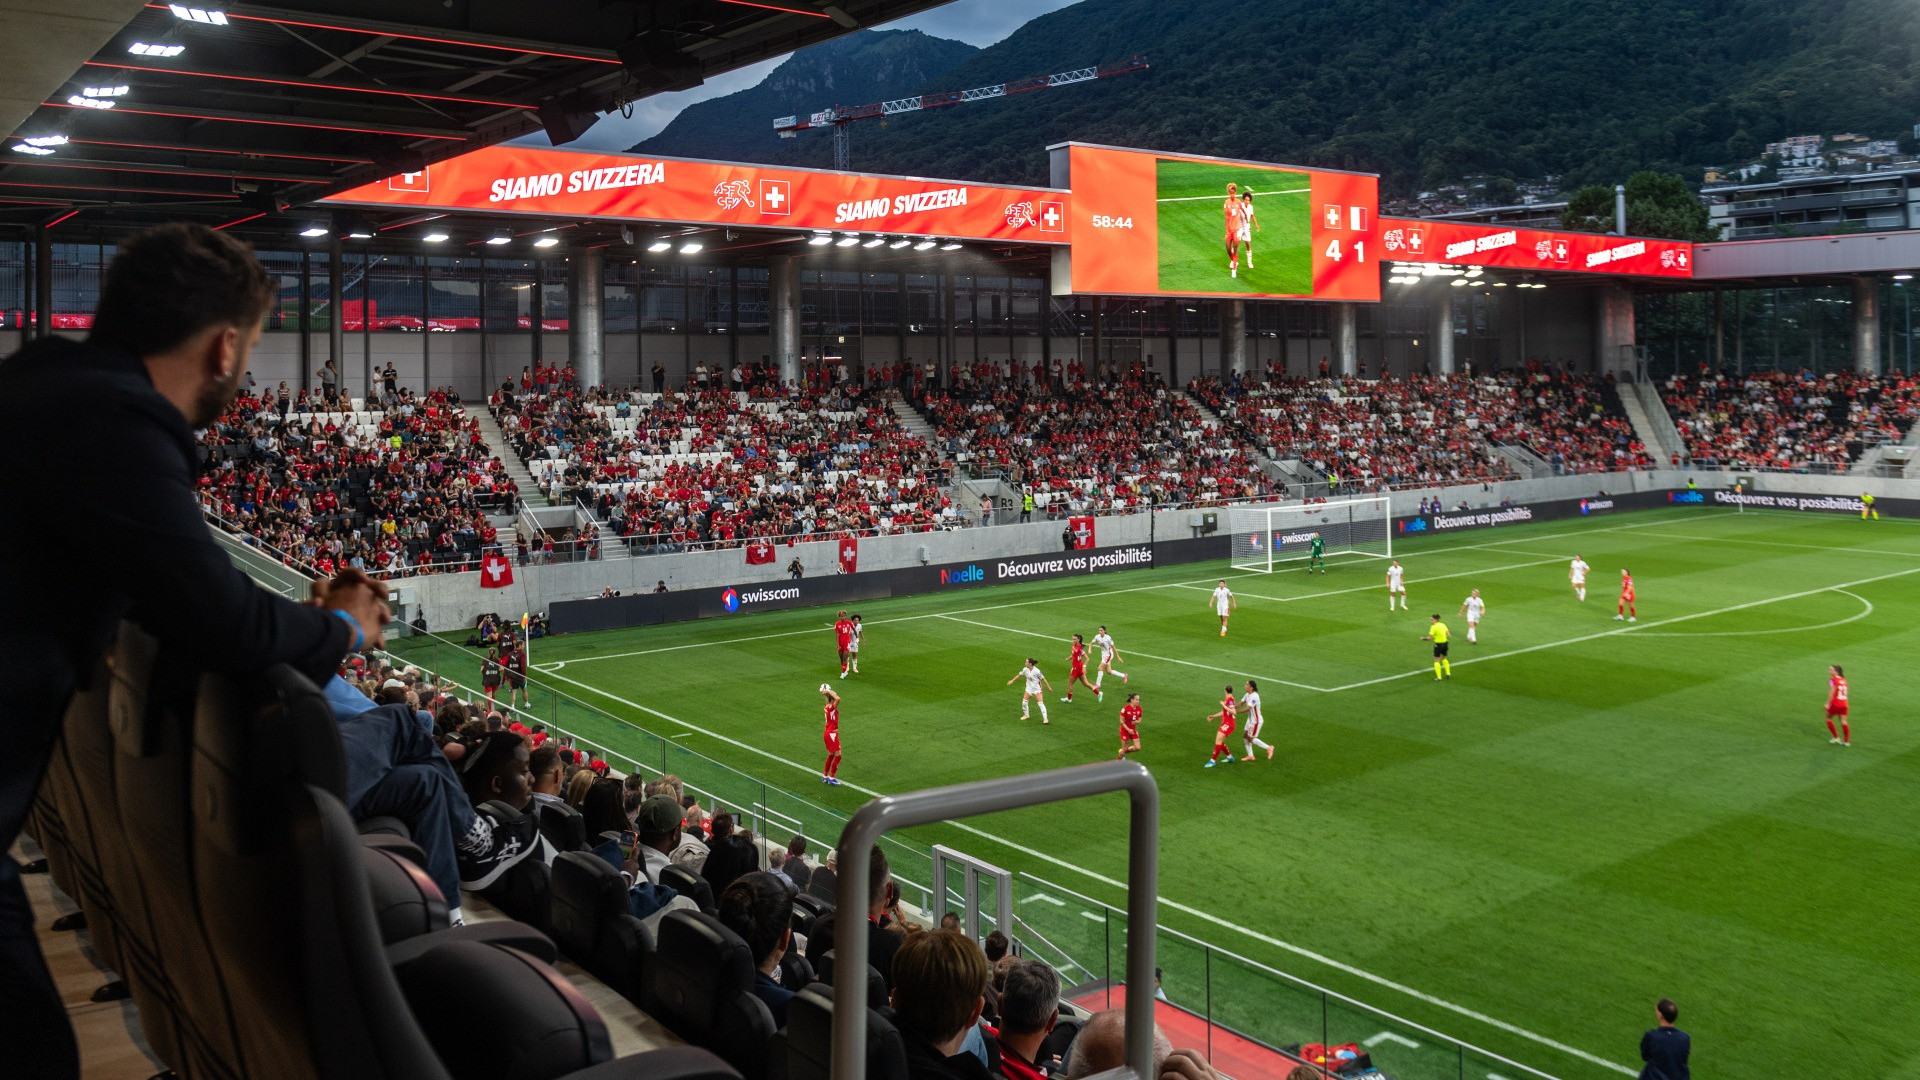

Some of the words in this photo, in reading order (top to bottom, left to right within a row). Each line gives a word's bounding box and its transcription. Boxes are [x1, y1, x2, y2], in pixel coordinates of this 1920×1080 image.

[490, 173, 562, 202] SIAMO
[567, 162, 664, 193] SVIZZERA
[835, 198, 890, 223] SIAMO
[893, 187, 967, 215] SVIZZERA
[1092, 215, 1133, 229] 58:44
[1326, 240, 1342, 261] 4
[1354, 241, 1364, 262] 1
[1001, 498, 1013, 510] B3
[1714, 490, 1775, 505] Découvrez
[1776, 497, 1797, 507] vos
[1800, 496, 1865, 511] possibilités
[1434, 515, 1475, 529] Découvrez
[1476, 514, 1490, 525] vos
[1281, 532, 1315, 544] swisscom
[941, 565, 984, 584] Noelle
[998, 560, 1063, 578] Découvrez
[1065, 557, 1086, 571] vos
[1090, 547, 1152, 572] possibilités
[741, 587, 800, 604] swisscom
